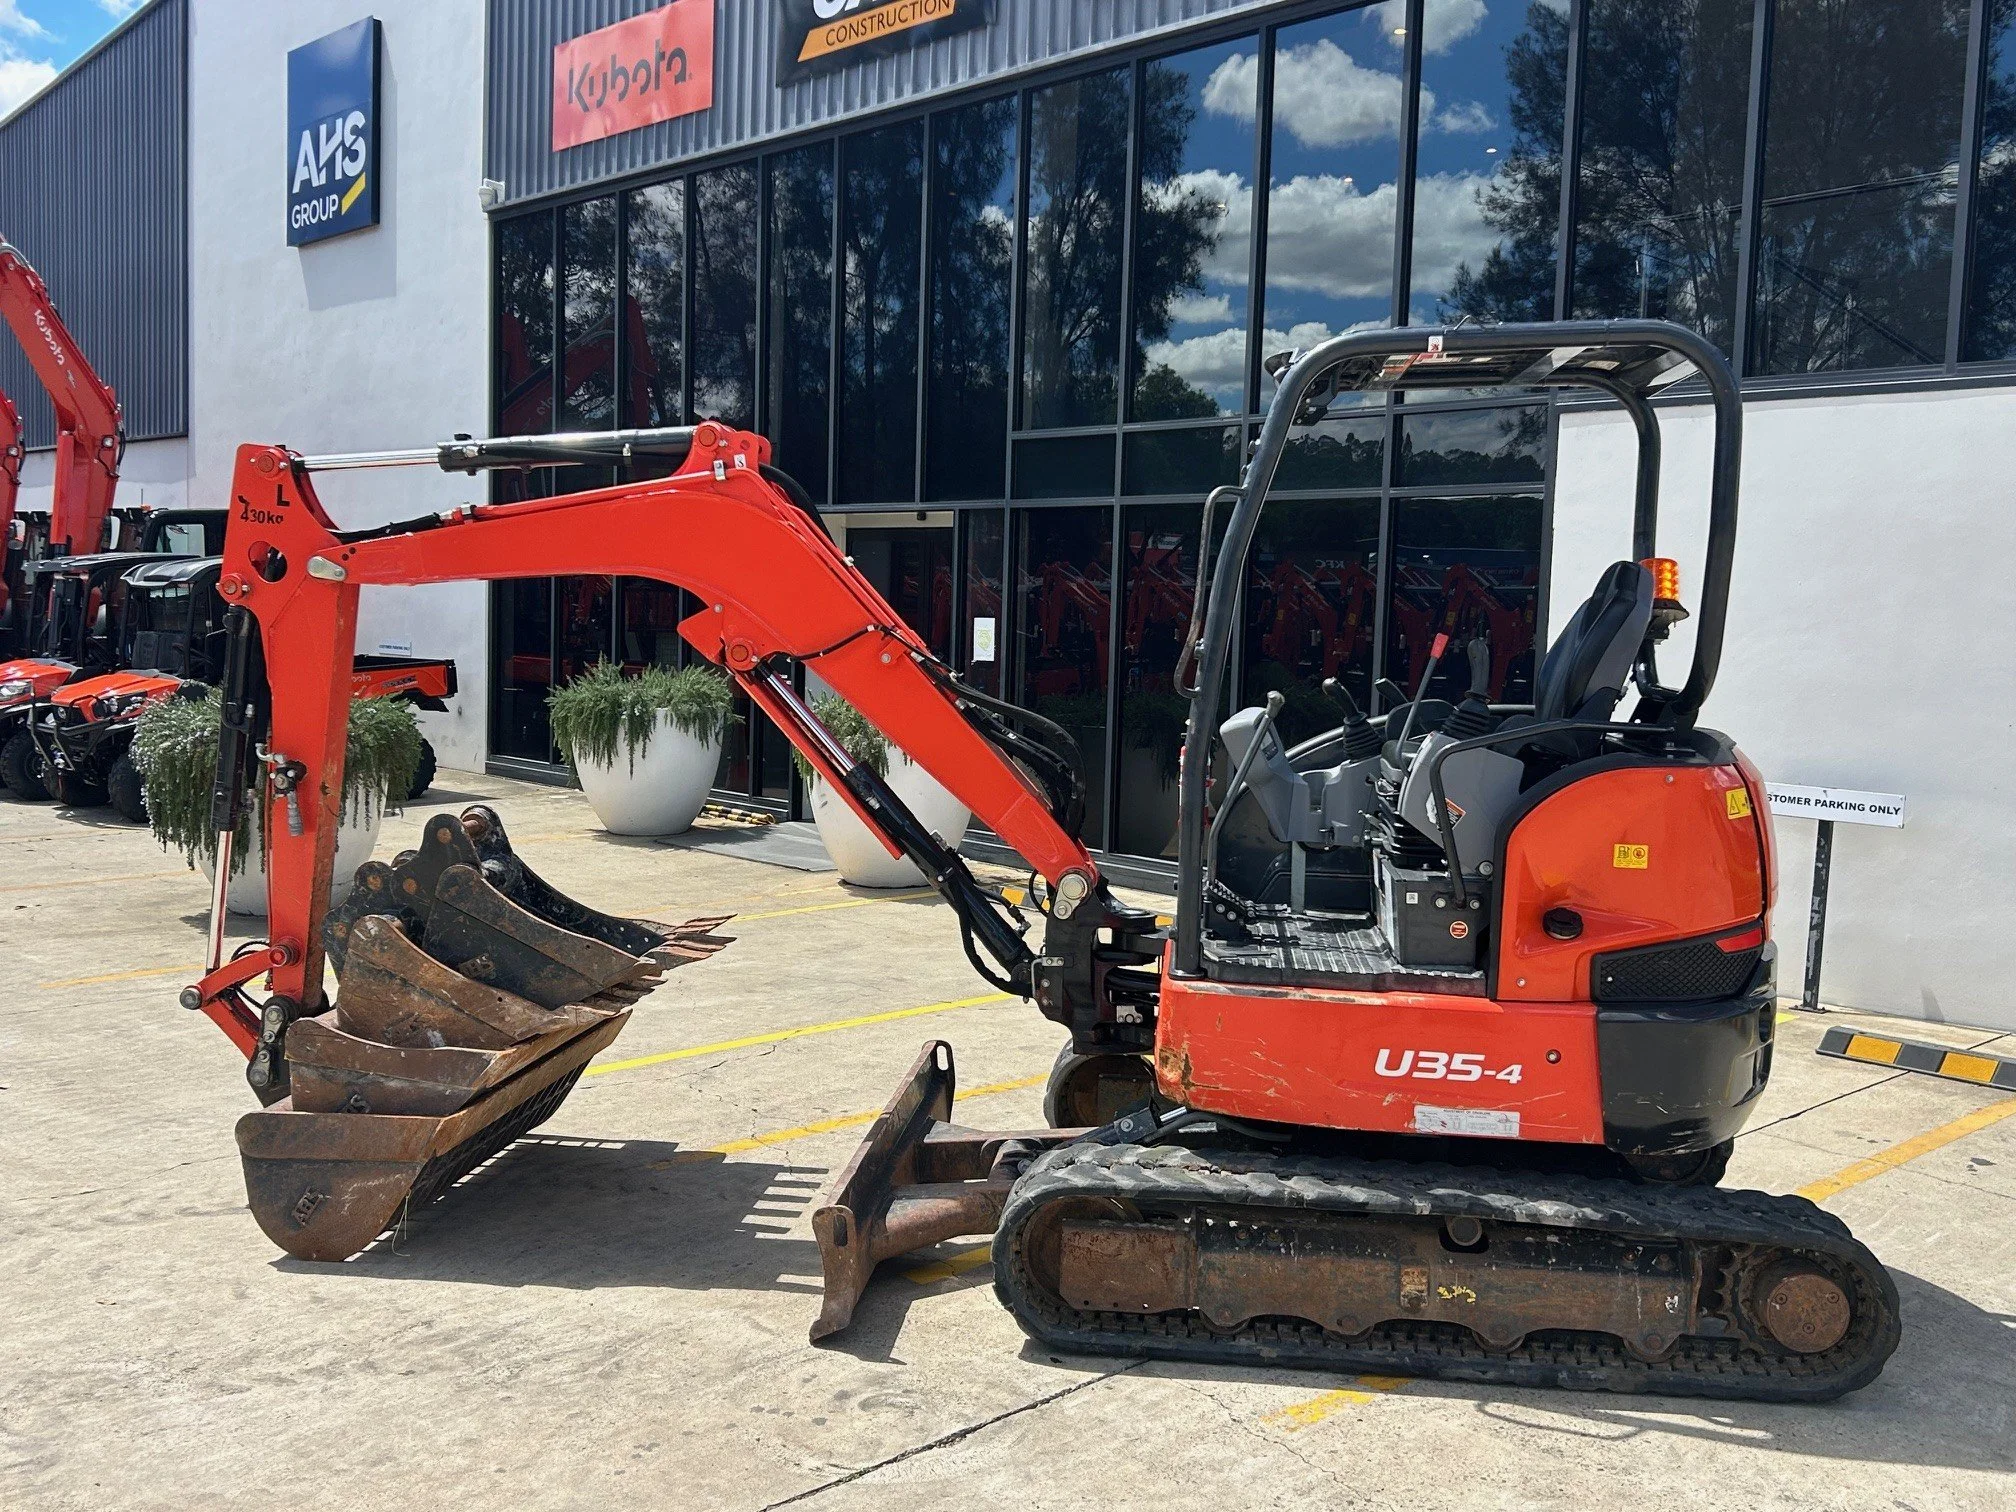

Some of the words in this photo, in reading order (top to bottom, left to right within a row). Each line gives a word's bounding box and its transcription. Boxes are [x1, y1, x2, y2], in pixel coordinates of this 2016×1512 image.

[825, 0, 950, 46] CONSTRUCTION
[567, 38, 688, 113] Kubota
[292, 110, 366, 194] AHS
[291, 193, 339, 229] GROUP
[34, 309, 65, 366] Kubota
[1767, 793, 1811, 806] STOMER
[1814, 799, 1865, 812] PARKING
[1869, 804, 1901, 815] ONLY
[1374, 1048, 1523, 1084] U35-4
